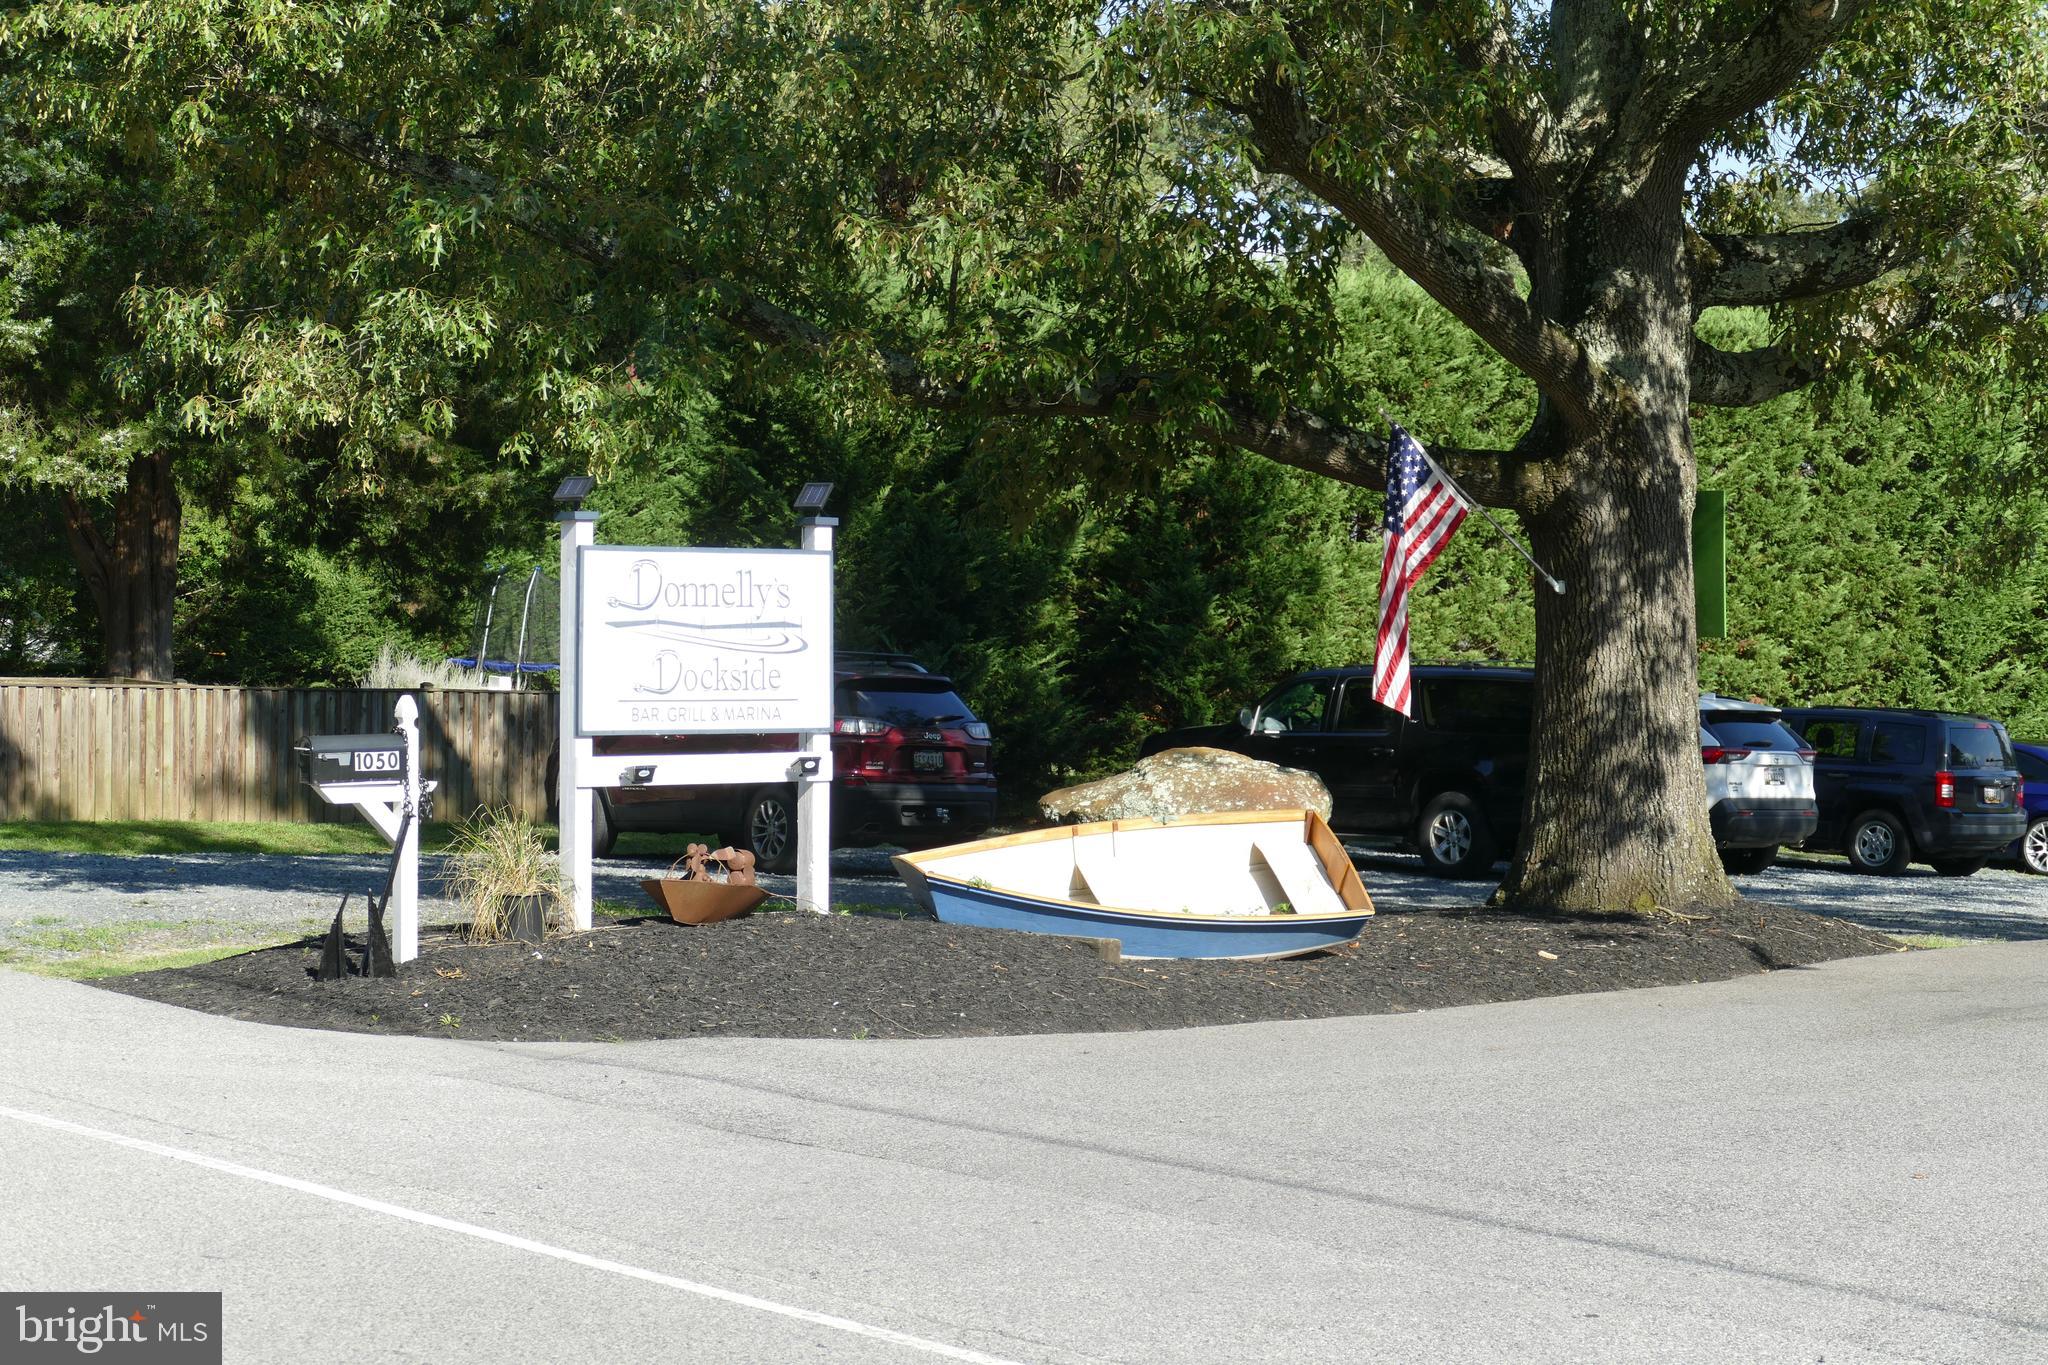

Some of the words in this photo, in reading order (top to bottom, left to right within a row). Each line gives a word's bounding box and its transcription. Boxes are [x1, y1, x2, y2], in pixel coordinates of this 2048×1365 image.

[608, 559, 790, 620] Donnelly's
[634, 650, 781, 694] Dockside
[668, 707, 706, 722] GRILL
[711, 706, 720, 721] &
[724, 706, 782, 721] MARINA
[923, 732, 941, 740] Jeep
[356, 752, 398, 770] 1050
